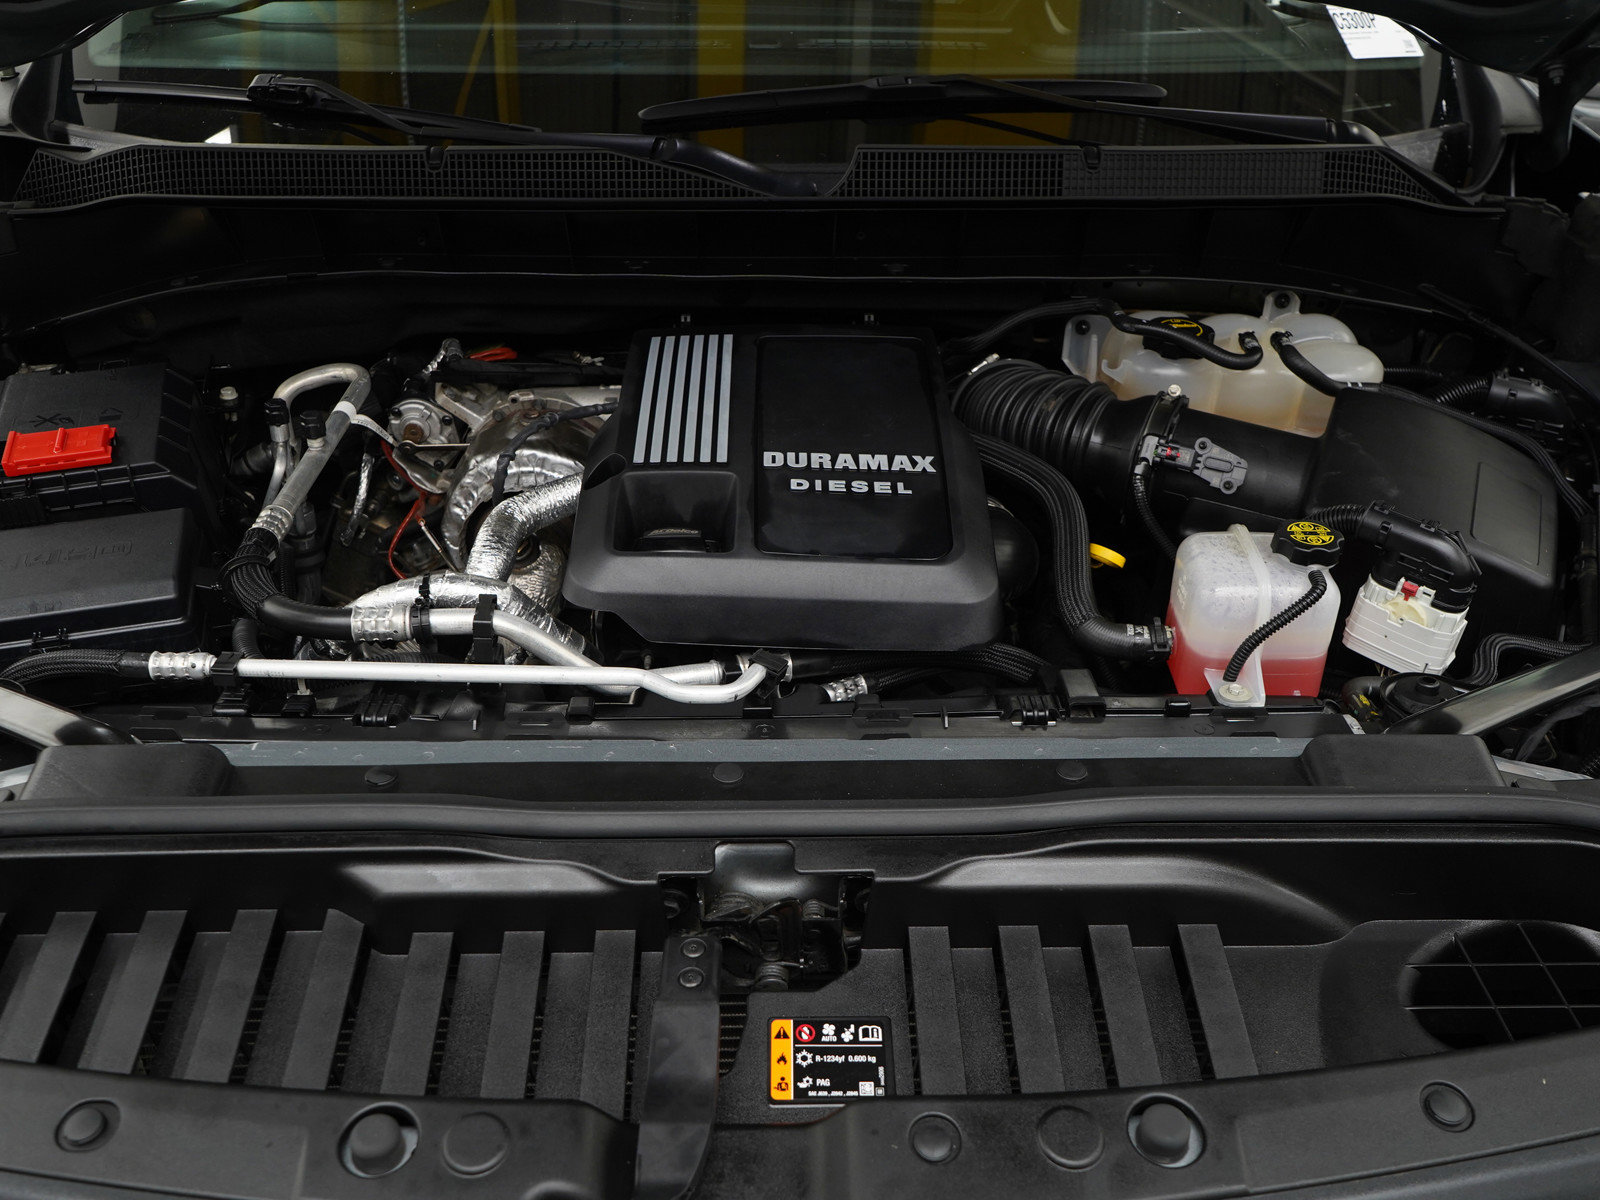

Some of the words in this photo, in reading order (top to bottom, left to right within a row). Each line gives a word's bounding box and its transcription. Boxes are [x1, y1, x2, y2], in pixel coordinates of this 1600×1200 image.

[763, 451, 937, 473] DURAMAX
[790, 478, 912, 495] DIESEL
[815, 1055, 845, 1063] R-1234yf
[867, 1055, 876, 1063] kg
[816, 1078, 830, 1086] PAG
